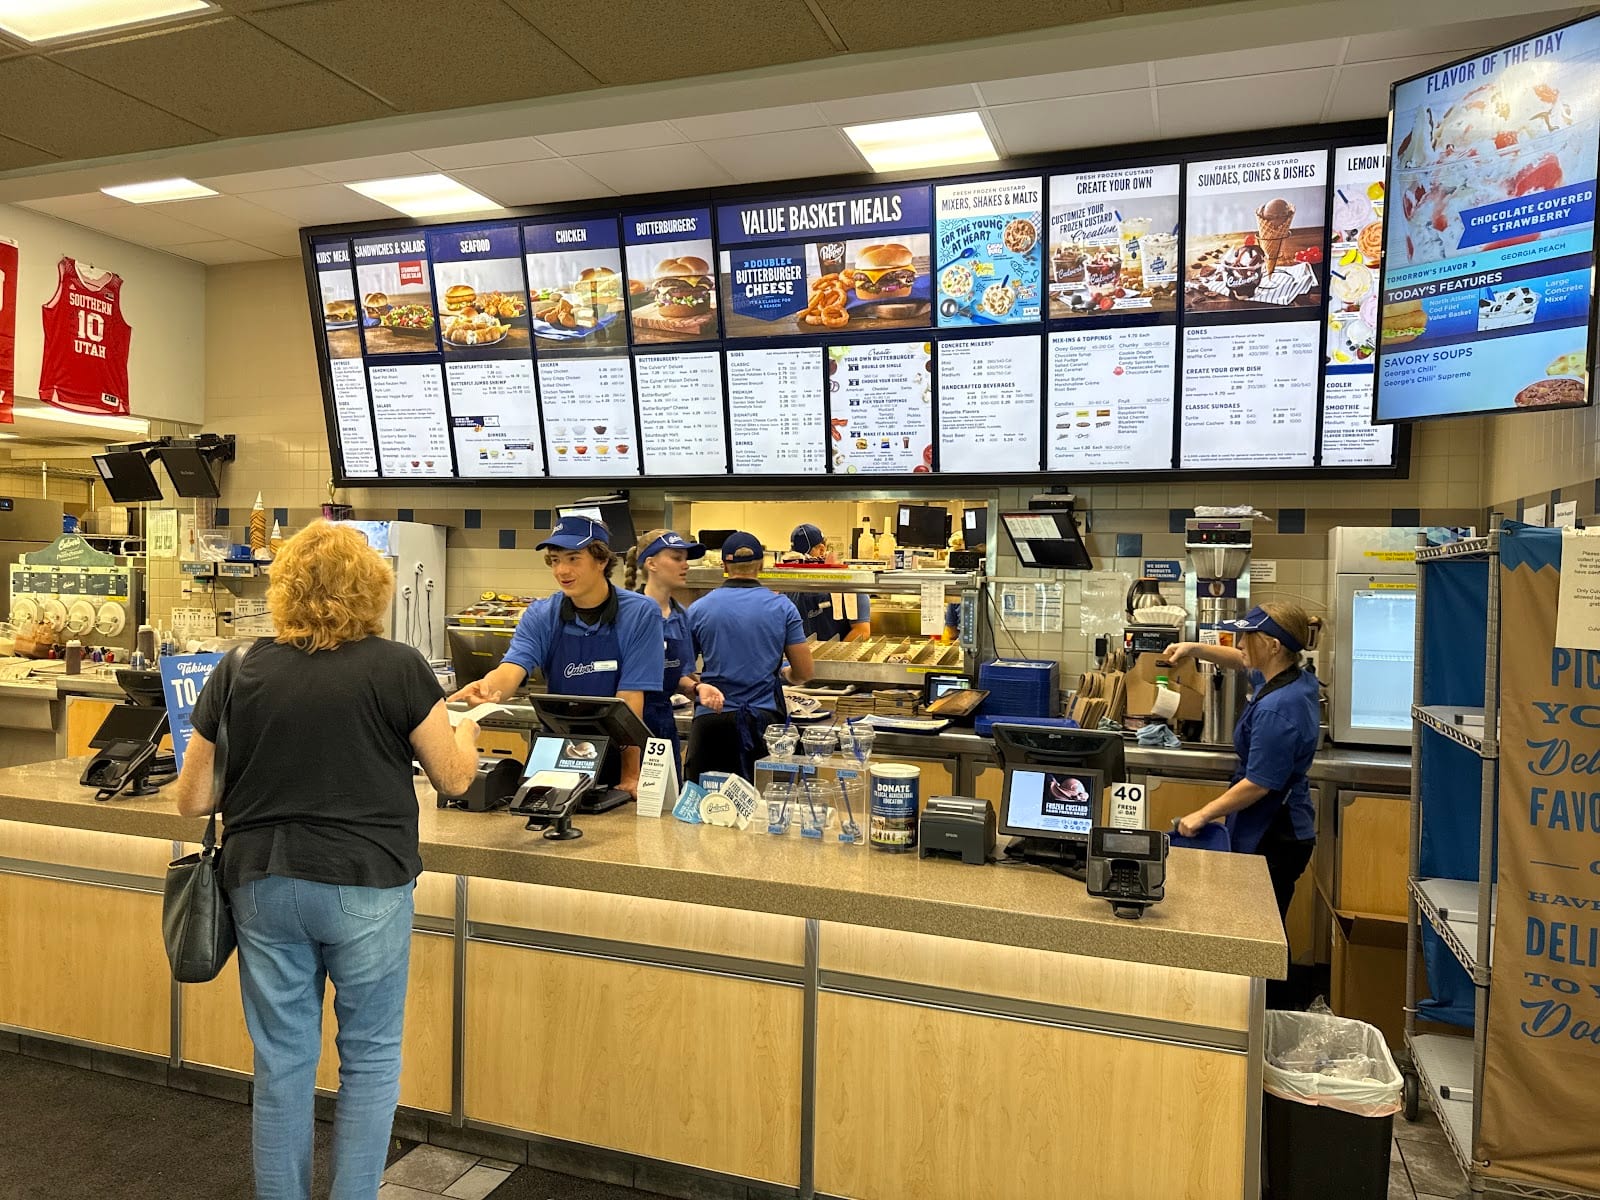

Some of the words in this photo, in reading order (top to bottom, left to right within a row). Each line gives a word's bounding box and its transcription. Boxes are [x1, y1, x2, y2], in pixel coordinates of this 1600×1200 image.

[1427, 62, 1475, 94] FLAVOR
[1482, 54, 1498, 75] OF
[1504, 43, 1529, 67] THE
[1534, 31, 1564, 58] DAY
[1238, 161, 1265, 169] FROZEN
[1267, 158, 1299, 166] CUSTARD
[1348, 156, 1379, 171] LEMON
[1125, 169, 1154, 177] CUSTARD
[1198, 172, 1240, 187] SUNDAES,
[1242, 169, 1271, 182] CONES
[1274, 168, 1280, 180] &
[1283, 164, 1315, 178] DISHES
[999, 185, 1026, 193] CUSTARD
[1077, 180, 1107, 195] CREATE
[1109, 179, 1131, 192] YOUR
[1133, 176, 1152, 189] OWN
[941, 199, 971, 211] MIXERS,
[973, 196, 1003, 209] SHAKES
[1004, 195, 1011, 205] &
[1012, 191, 1038, 204] MALTS
[1471, 202, 1535, 227] CHOCOLATE
[1537, 191, 1593, 212] COVERED
[741, 207, 786, 235] VALUE
[789, 201, 846, 231] BASKET
[850, 196, 902, 225] MEALS
[1051, 209, 1086, 226] CUSTOMIZE
[1087, 203, 1104, 216] YOUR
[1059, 219, 1083, 234] FROZEN
[1084, 212, 1113, 228] CUSTARD
[1492, 208, 1571, 234] STRAWBERRY
[556, 228, 587, 243] CHICKEN
[941, 233, 955, 247] FOR
[956, 226, 971, 240] THE
[971, 218, 1003, 234] YOUNG
[1071, 224, 1118, 244] Creation
[355, 242, 394, 258] SANDWICHES
[394, 243, 400, 253] &
[401, 240, 425, 253] SALADS
[460, 239, 490, 253] SEAFOOD
[952, 242, 962, 255] AT
[963, 231, 991, 247] HEART
[1501, 249, 1537, 261] GEORGIA
[1539, 242, 1566, 254] PEACH
[750, 258, 787, 267] DOUBLE
[821, 247, 843, 261] Pepper
[736, 266, 801, 284] BUTTERBURGER
[1387, 268, 1437, 284] TOMORROW'S
[1439, 262, 1468, 274] FLAVOR
[745, 281, 793, 298] CHEESE
[1388, 285, 1436, 302] TODAY'S
[1439, 272, 1503, 292] FEATURES
[1544, 283, 1584, 295] Concrete
[1546, 277, 1569, 288] Large
[69, 292, 112, 315] SOUTHERN
[1429, 297, 1448, 307] North
[1450, 293, 1477, 304] Atlantic
[1428, 305, 1442, 314] Cod
[1429, 312, 1447, 321] Value
[1449, 308, 1472, 318] Basket
[77, 309, 104, 342] 10
[74, 339, 106, 359] UTAH
[1384, 353, 1430, 368] SAVORY
[1433, 348, 1473, 362] SOUPS
[1384, 367, 1416, 377] George's
[1384, 376, 1416, 387] George's
[1438, 370, 1472, 380] Supreme
[177, 661, 213, 676] Taking
[647, 742, 666, 756] 39
[703, 780, 719, 789] ONION
[877, 784, 910, 792] DONATE
[1114, 786, 1142, 802] 40
[1526, 916, 1600, 968] DELI
[1524, 972, 1580, 994] TO
